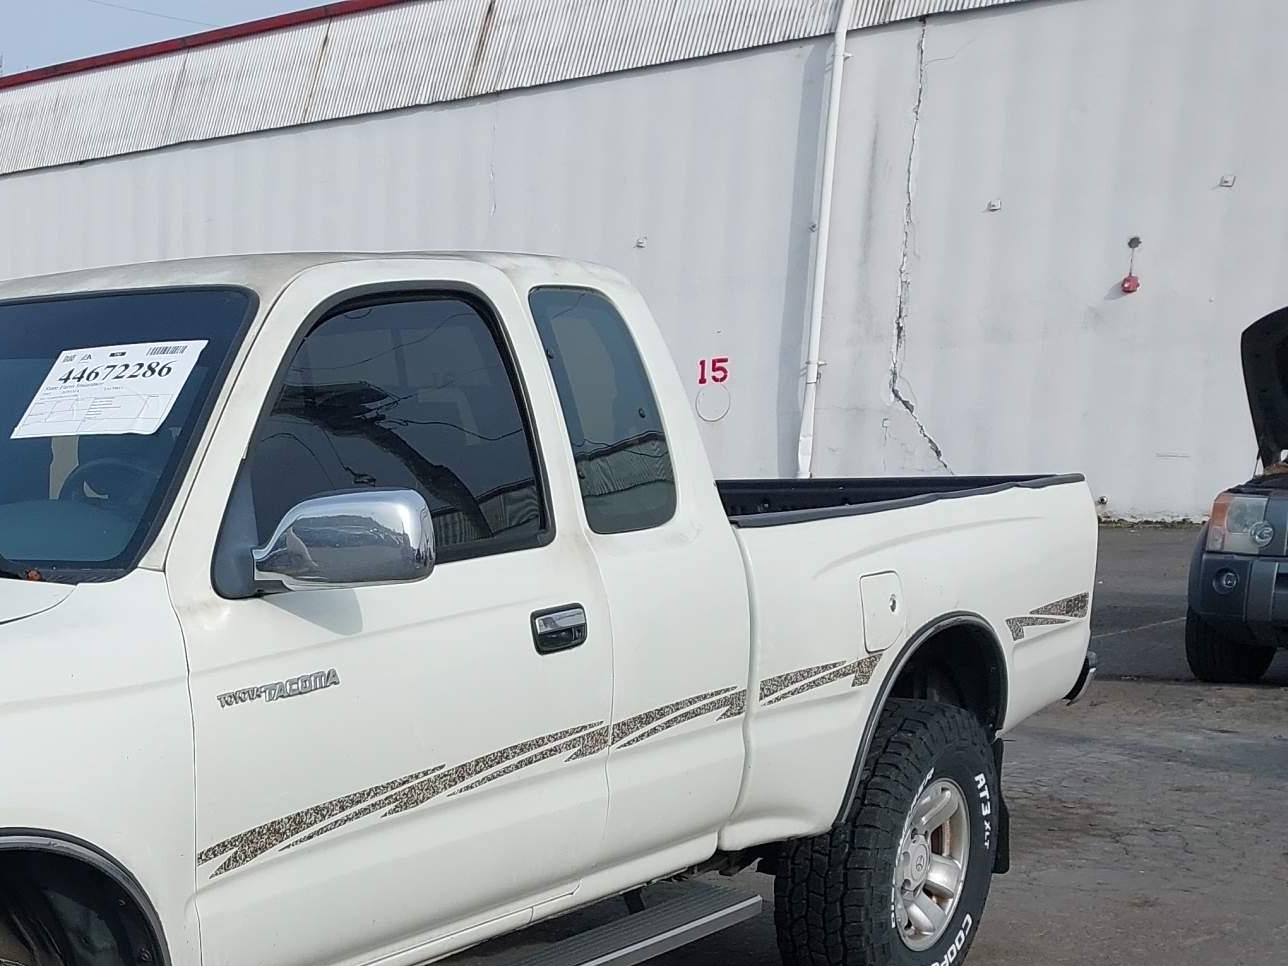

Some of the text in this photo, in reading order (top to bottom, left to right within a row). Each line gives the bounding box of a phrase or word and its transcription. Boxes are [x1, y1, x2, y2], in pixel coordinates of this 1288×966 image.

[58, 361, 177, 383] 44672286
[698, 357, 729, 385] 15
[216, 668, 340, 708] TOYOTA TACOMA
[974, 772, 992, 850] AT3 XLT
